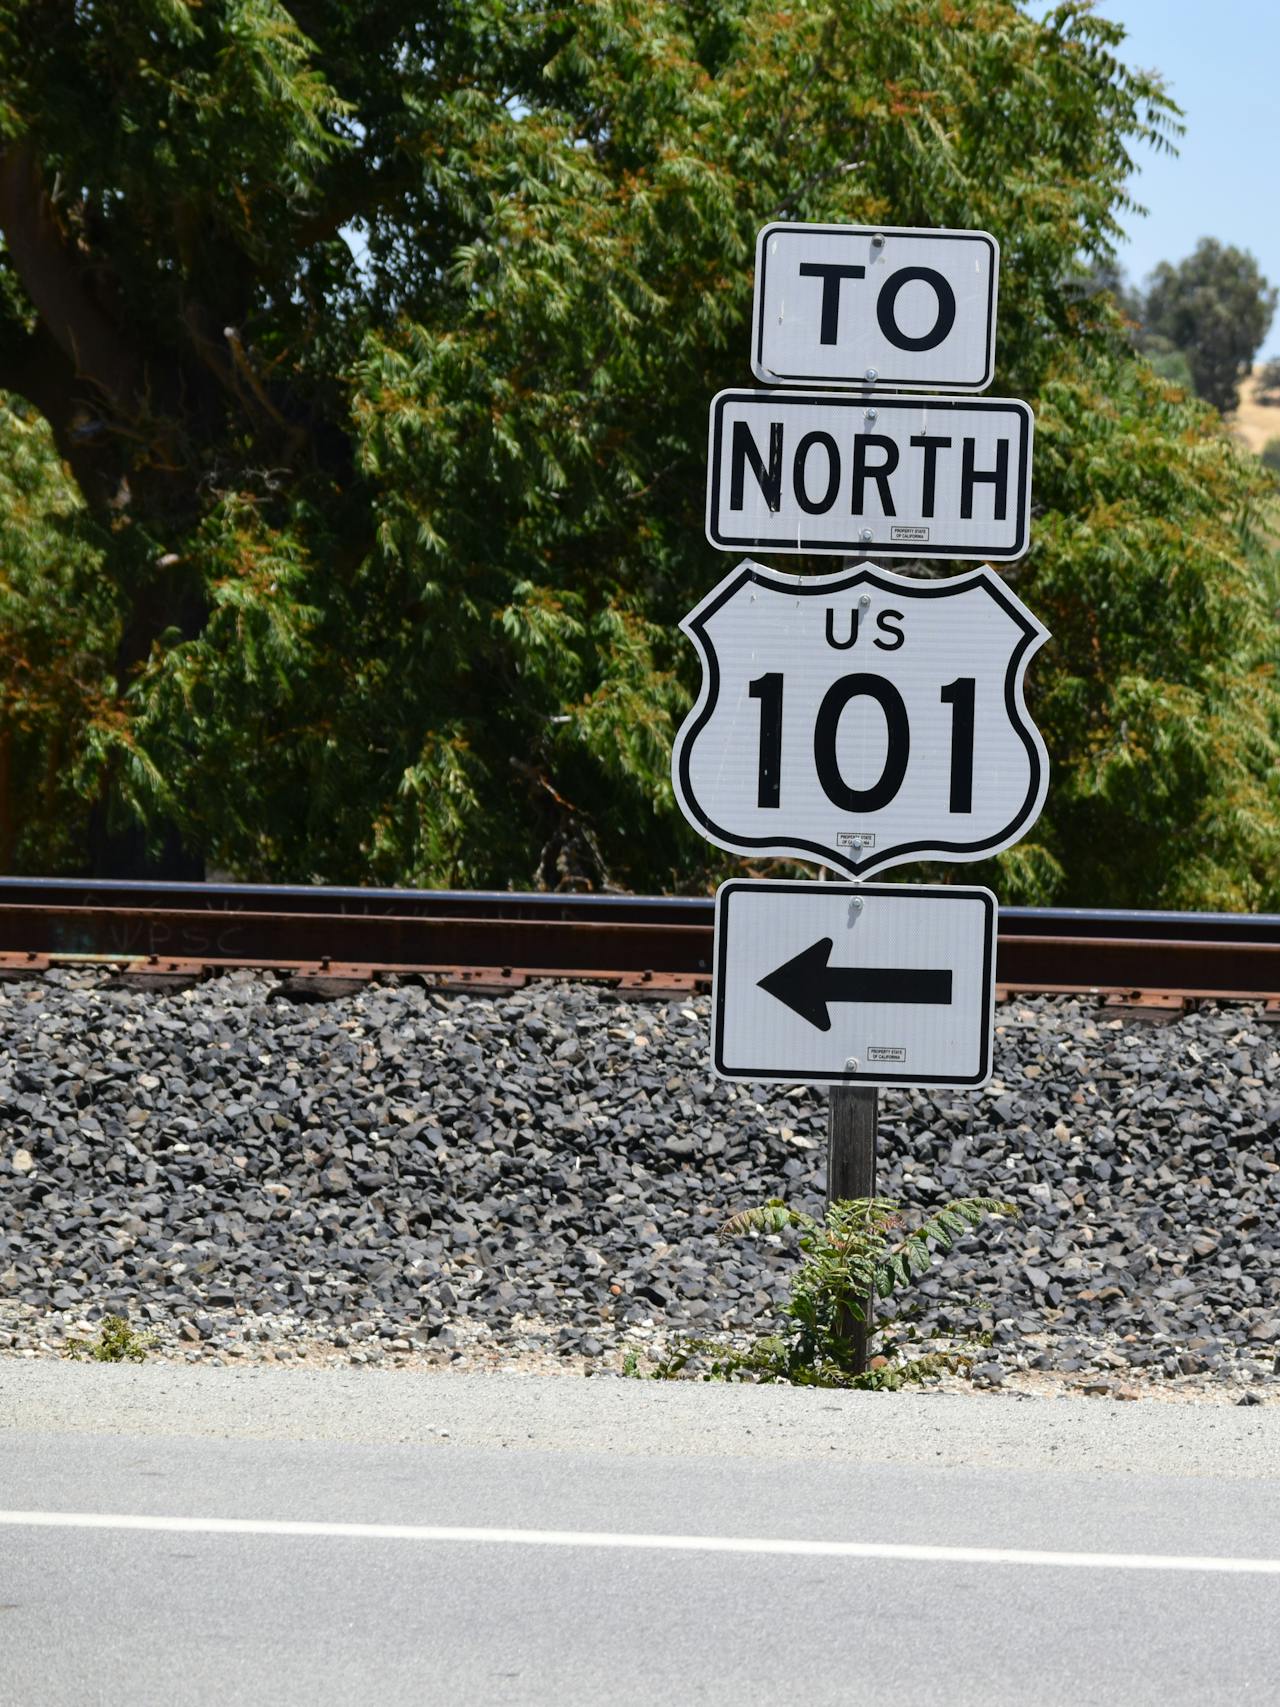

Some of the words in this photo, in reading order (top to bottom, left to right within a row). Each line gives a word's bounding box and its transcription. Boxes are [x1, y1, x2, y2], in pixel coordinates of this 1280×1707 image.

[800, 262, 956, 352] TO
[730, 421, 1009, 520] NORTH
[825, 607, 905, 651] US
[748, 672, 976, 814] 101
